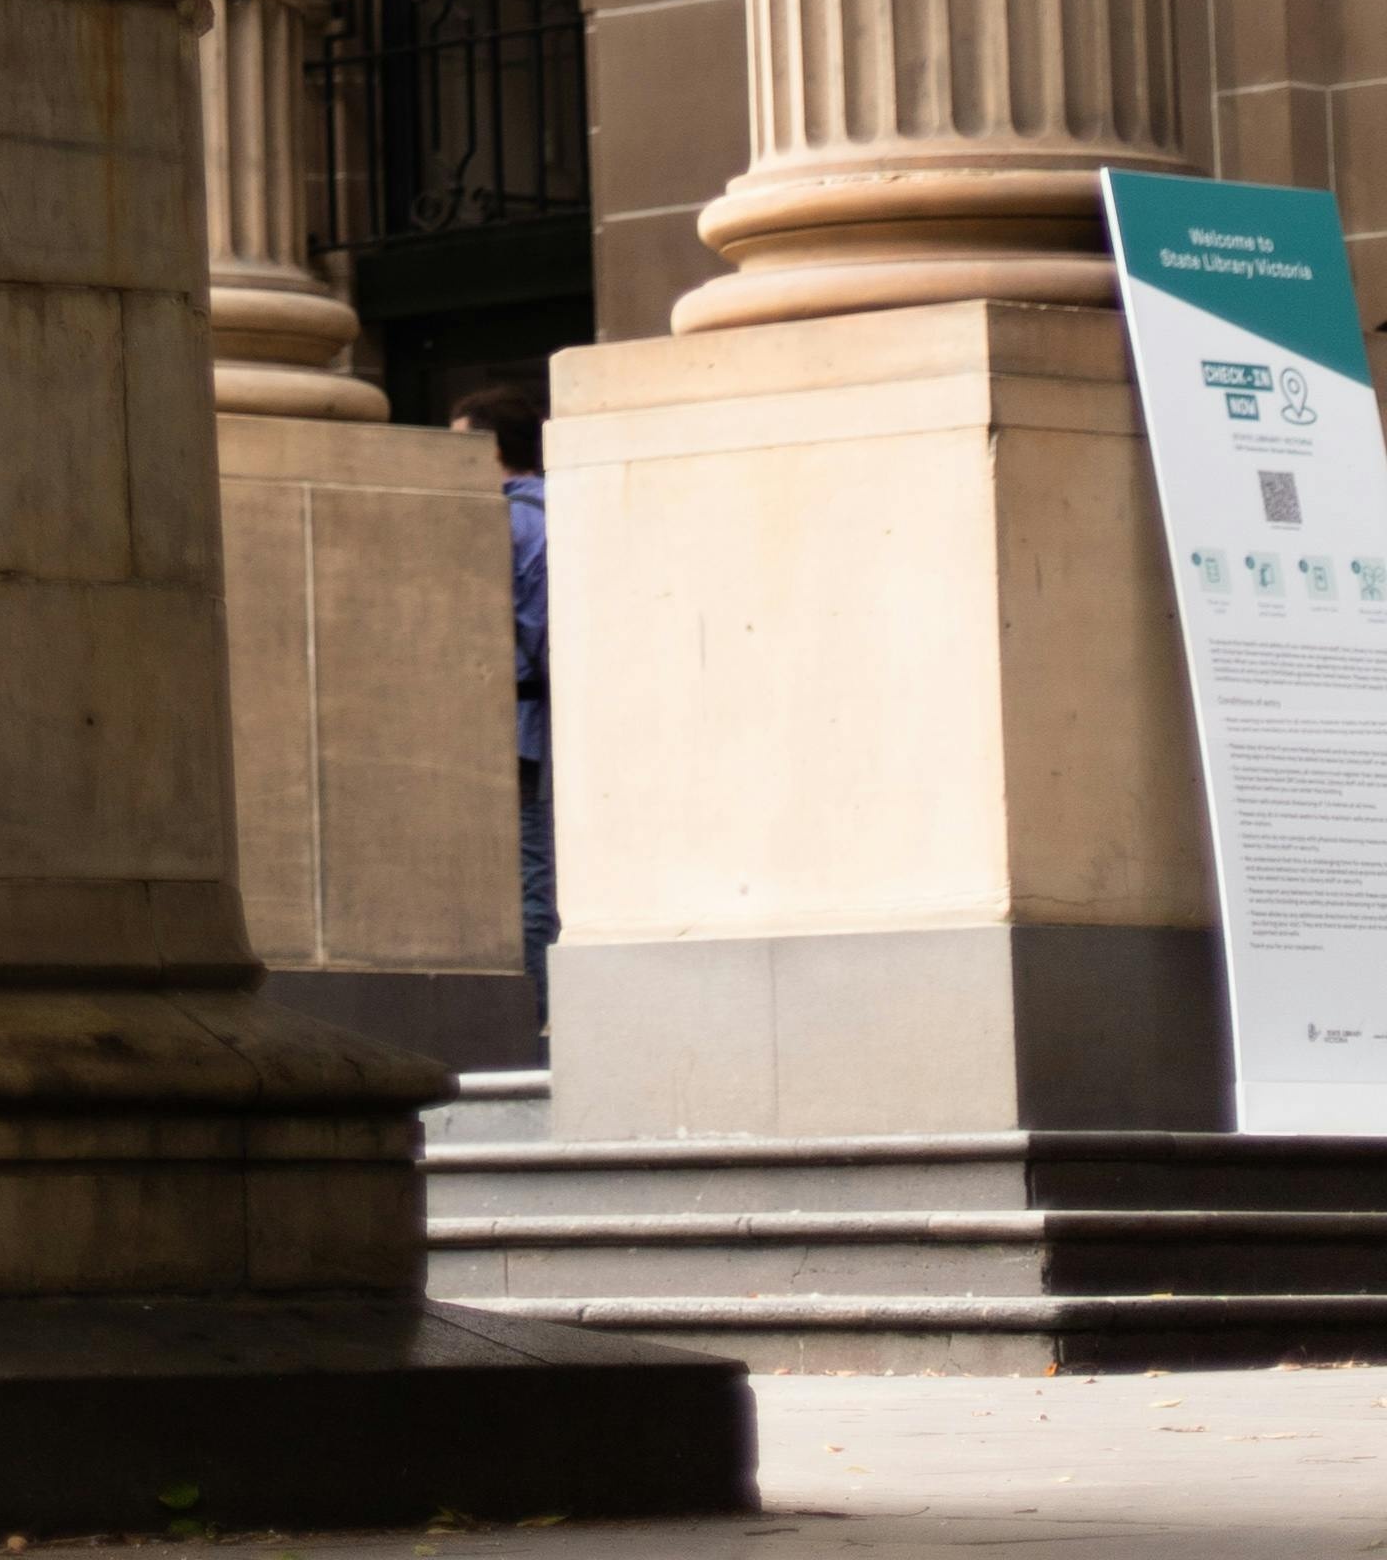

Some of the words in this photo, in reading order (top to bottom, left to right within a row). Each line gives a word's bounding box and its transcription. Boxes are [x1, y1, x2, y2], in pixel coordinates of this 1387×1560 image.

[1188, 227, 1256, 252] Welcome
[1257, 234, 1275, 254] to
[1159, 247, 1201, 270] State
[1202, 253, 1255, 280] Library
[1253, 257, 1313, 281] Victoria
